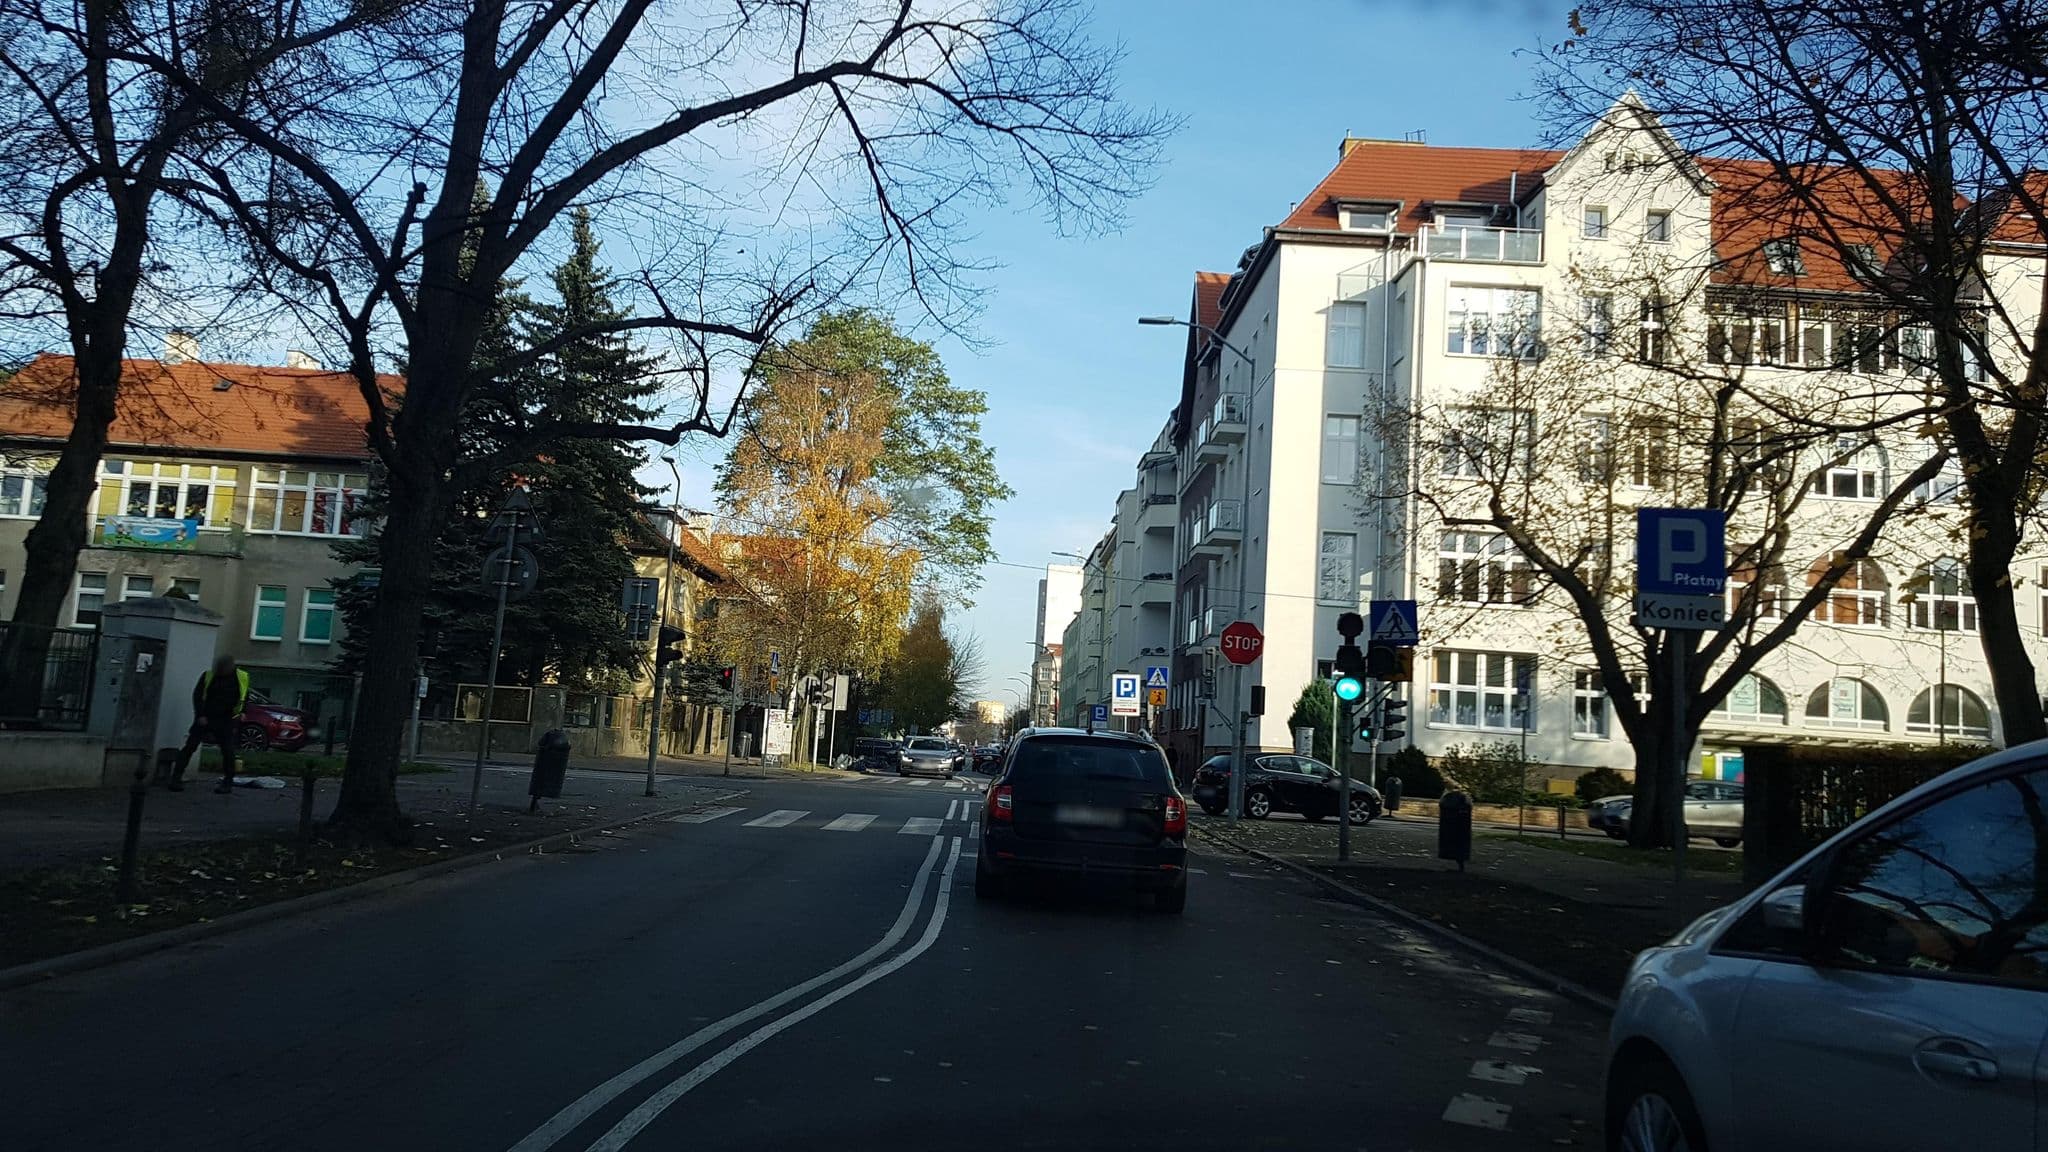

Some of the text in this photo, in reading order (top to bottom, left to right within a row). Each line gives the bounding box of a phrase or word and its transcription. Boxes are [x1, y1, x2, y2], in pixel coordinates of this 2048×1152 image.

[1658, 517, 1707, 582] P
[1674, 572, 1723, 590] Płatny
[1642, 599, 1722, 623] Koniec
[1224, 635, 1261, 650] STOP
[1120, 679, 1133, 696] P
